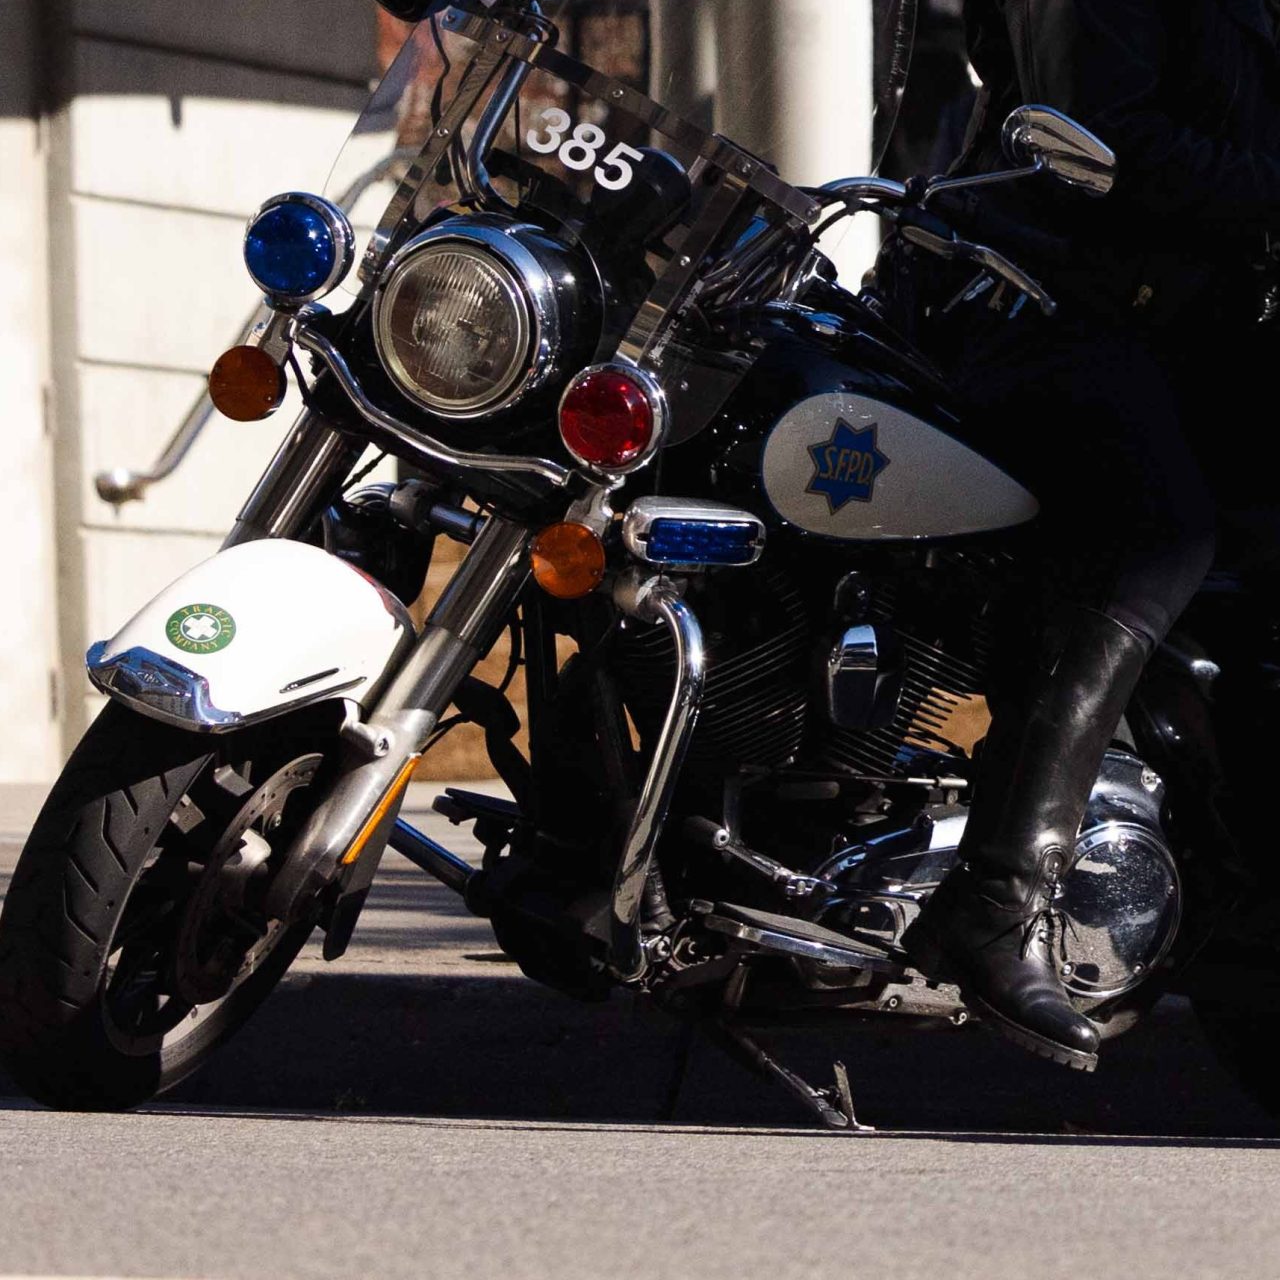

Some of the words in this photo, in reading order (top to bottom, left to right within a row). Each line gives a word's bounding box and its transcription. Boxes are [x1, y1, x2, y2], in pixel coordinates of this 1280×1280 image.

[526, 107, 645, 190] 385
[168, 620, 218, 651] COMPANY
[181, 605, 233, 638] TRAFFIC
